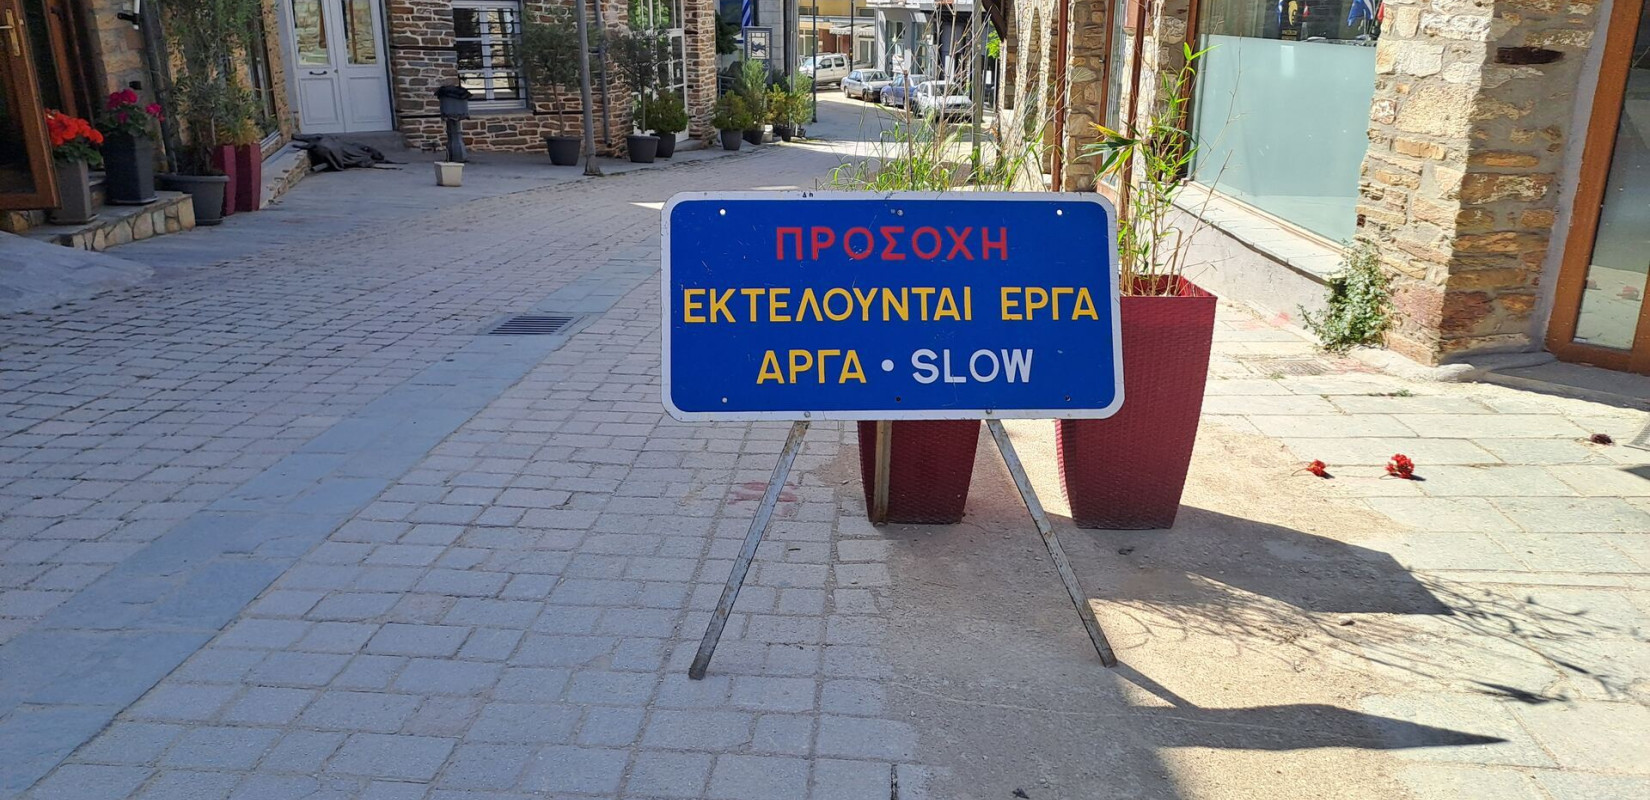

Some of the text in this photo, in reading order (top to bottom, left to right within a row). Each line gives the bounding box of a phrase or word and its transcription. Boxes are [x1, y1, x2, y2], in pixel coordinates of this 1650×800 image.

[775, 226, 1008, 261] ΠΡΟΣΟΧΗ
[683, 286, 1099, 323] ΕΚΤΕΛΟΥΝΤΑΙ ΕΡΓΑ
[756, 348, 1034, 385] ΑΡΓΑ SLOW
